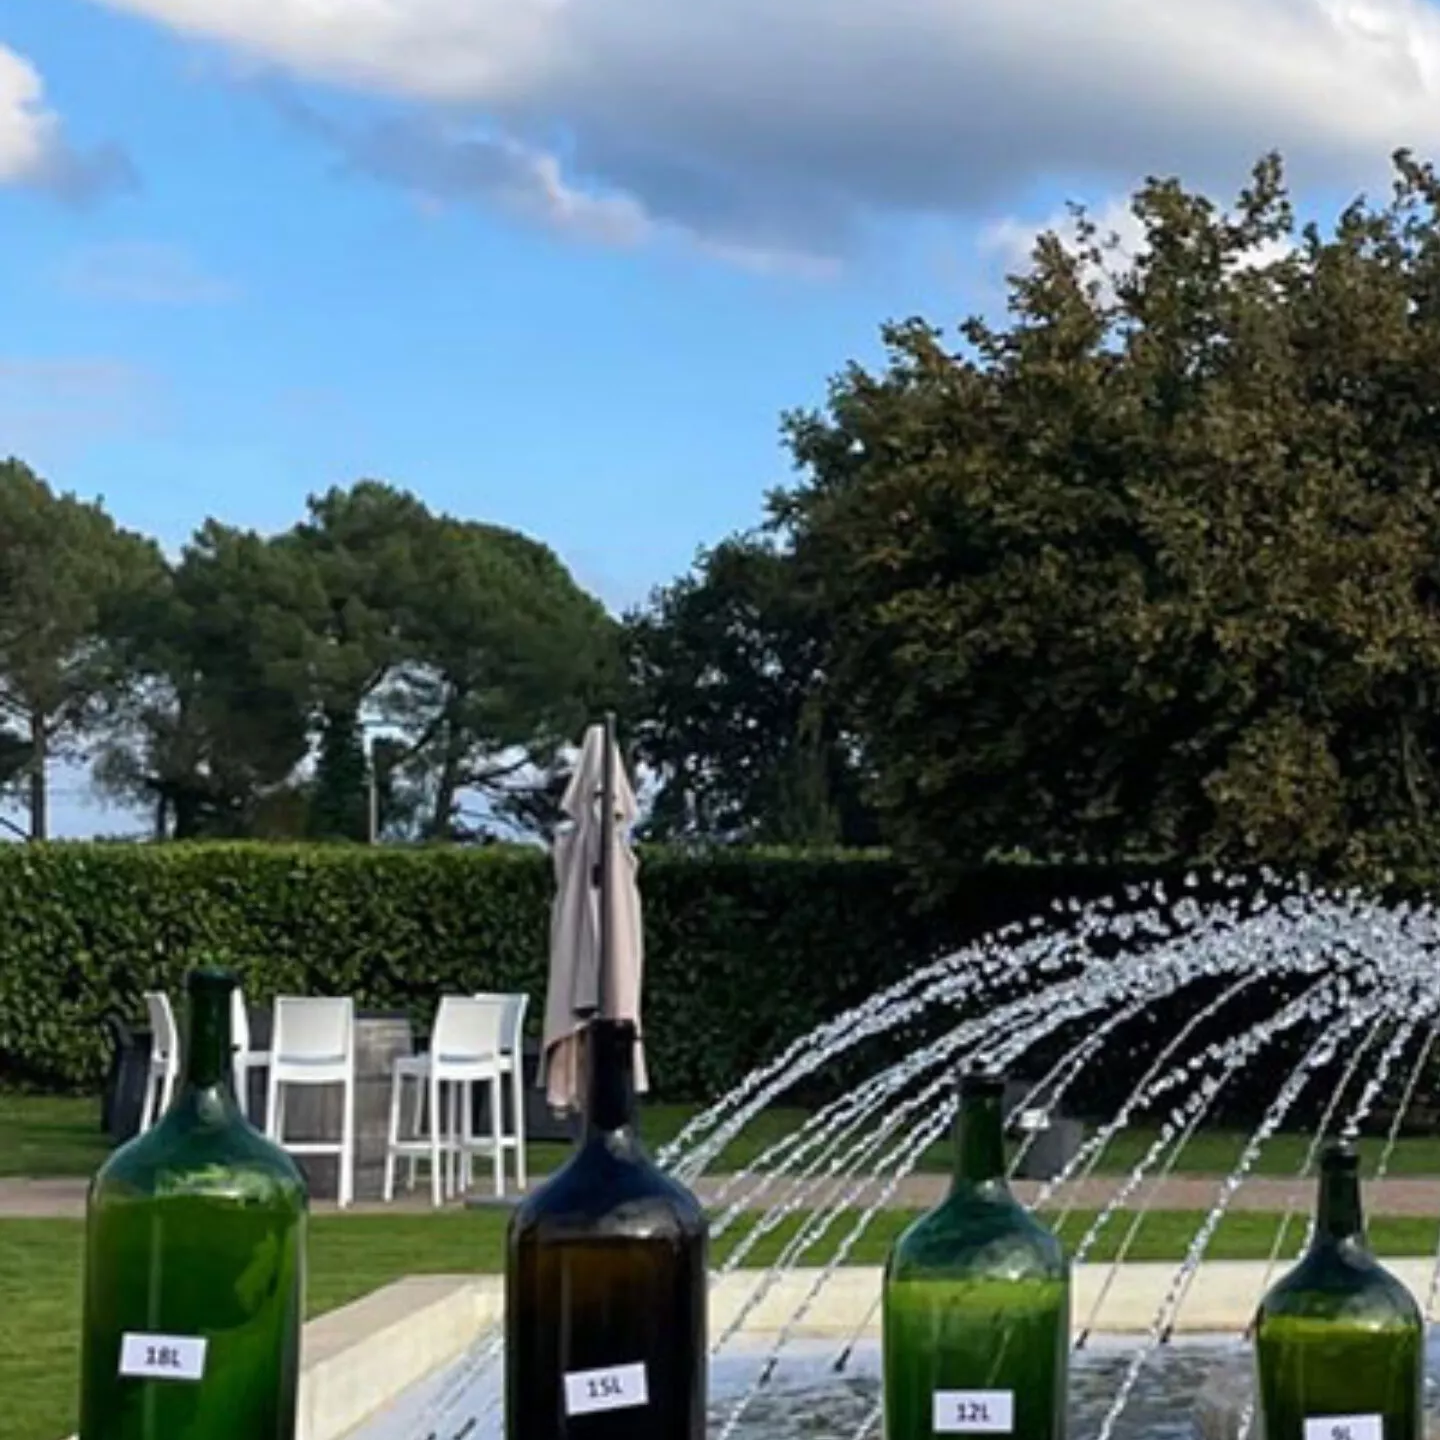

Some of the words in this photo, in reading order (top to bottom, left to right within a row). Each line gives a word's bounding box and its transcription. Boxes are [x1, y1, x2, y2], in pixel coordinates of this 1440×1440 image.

[145, 1345, 180, 1368] 18L
[587, 1374, 623, 1398] 15L
[956, 1402, 990, 1422] 12L
